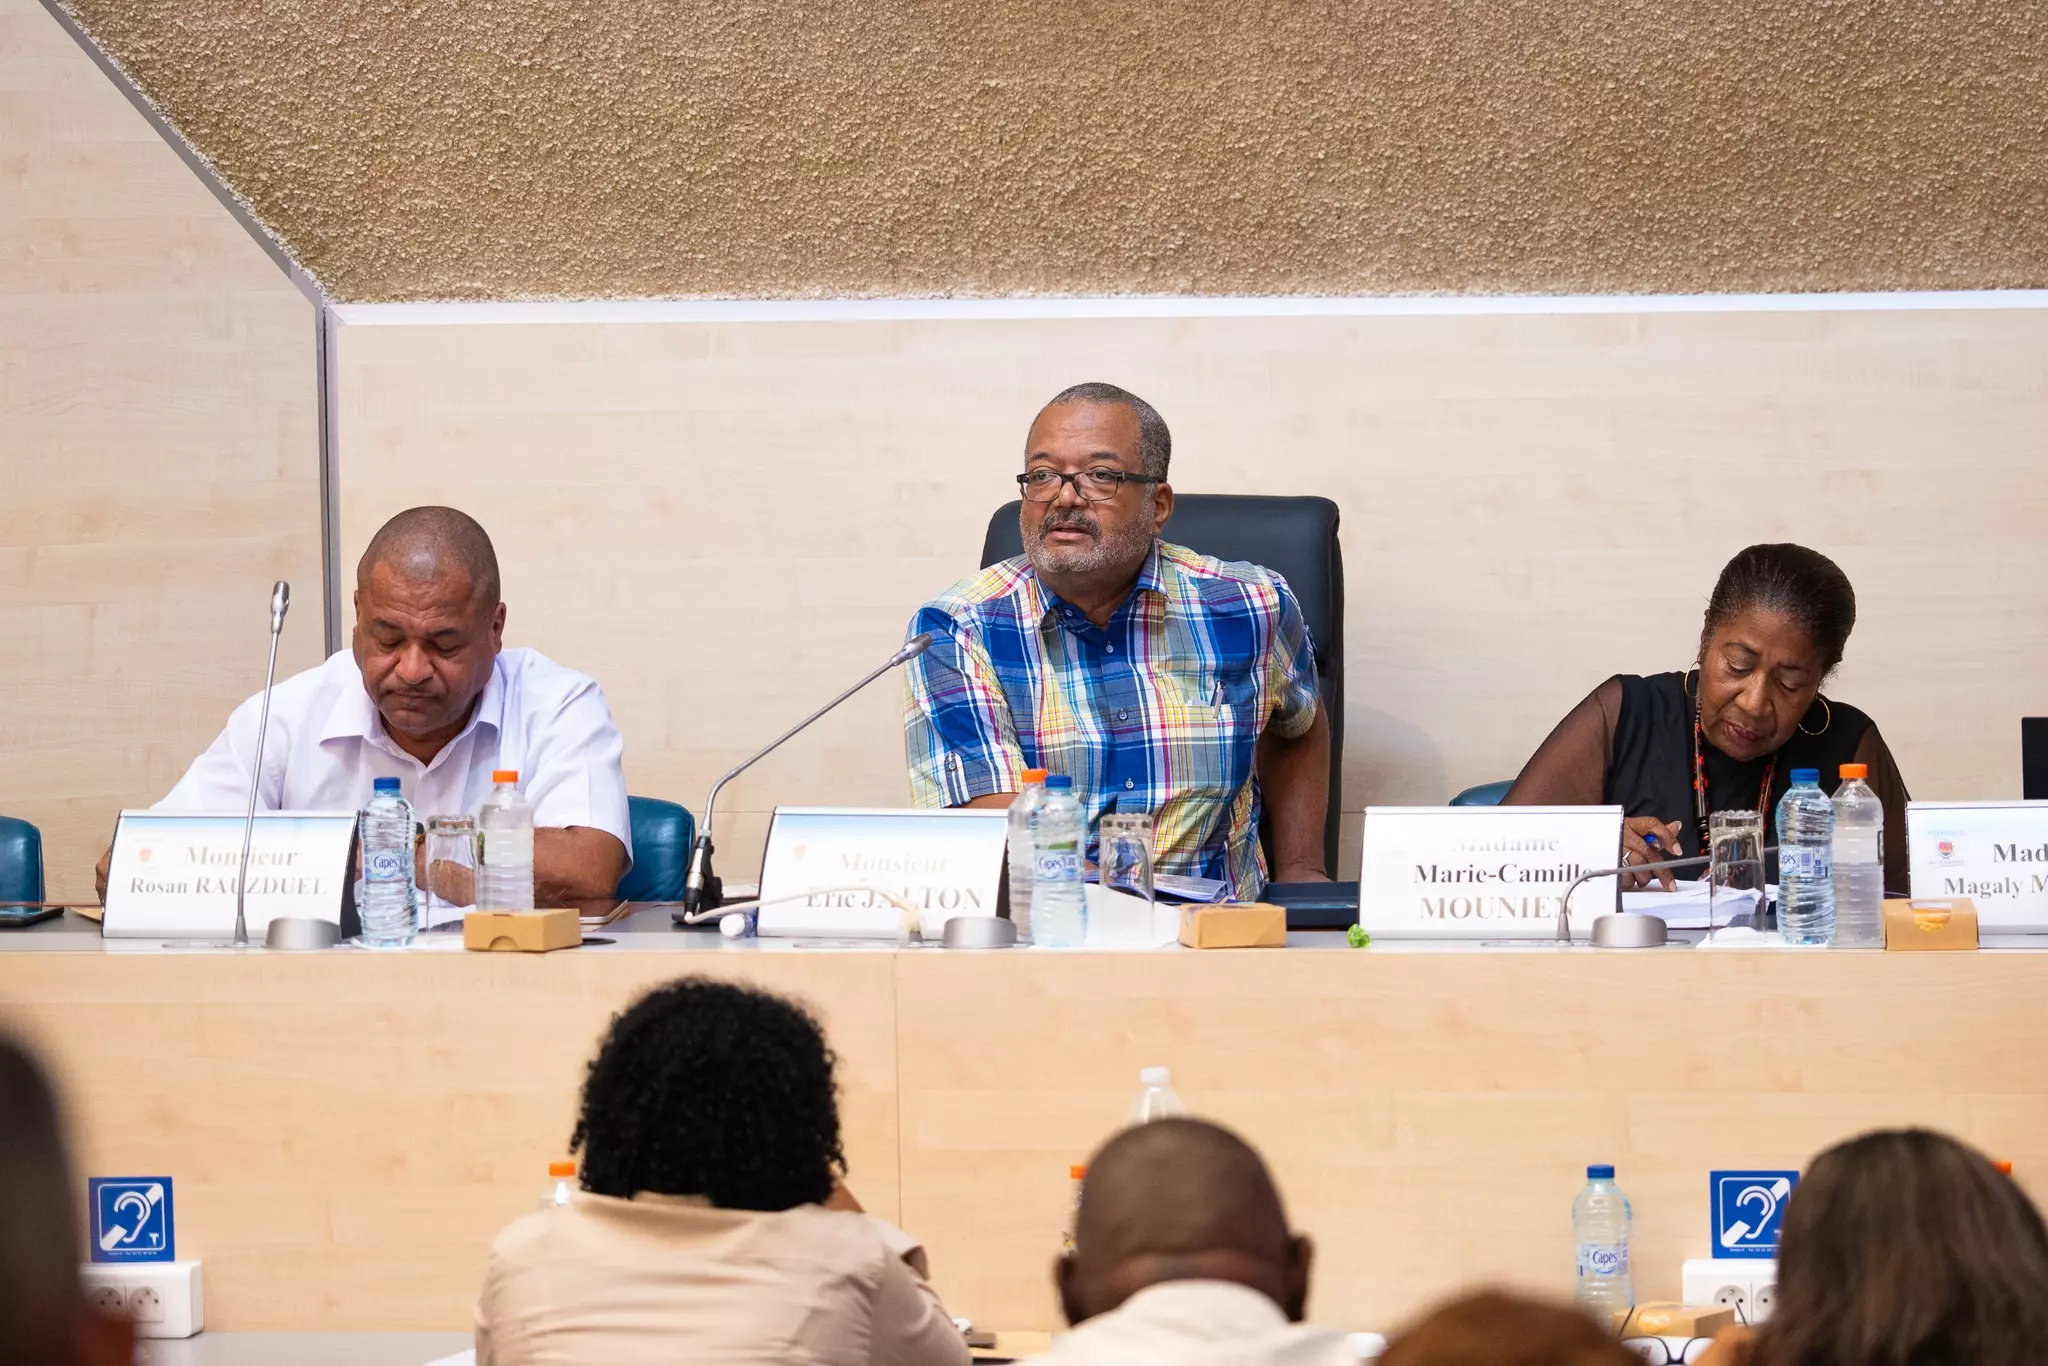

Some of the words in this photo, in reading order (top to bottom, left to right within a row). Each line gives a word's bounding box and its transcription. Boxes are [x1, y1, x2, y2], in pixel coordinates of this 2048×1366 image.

[1453, 835, 1560, 852] Madame
[1993, 843, 2048, 863] Mad
[184, 846, 299, 867] Monieur
[838, 851, 953, 874] Monsieur
[130, 876, 188, 894] Rosan
[1944, 877, 2023, 899] Magaly
